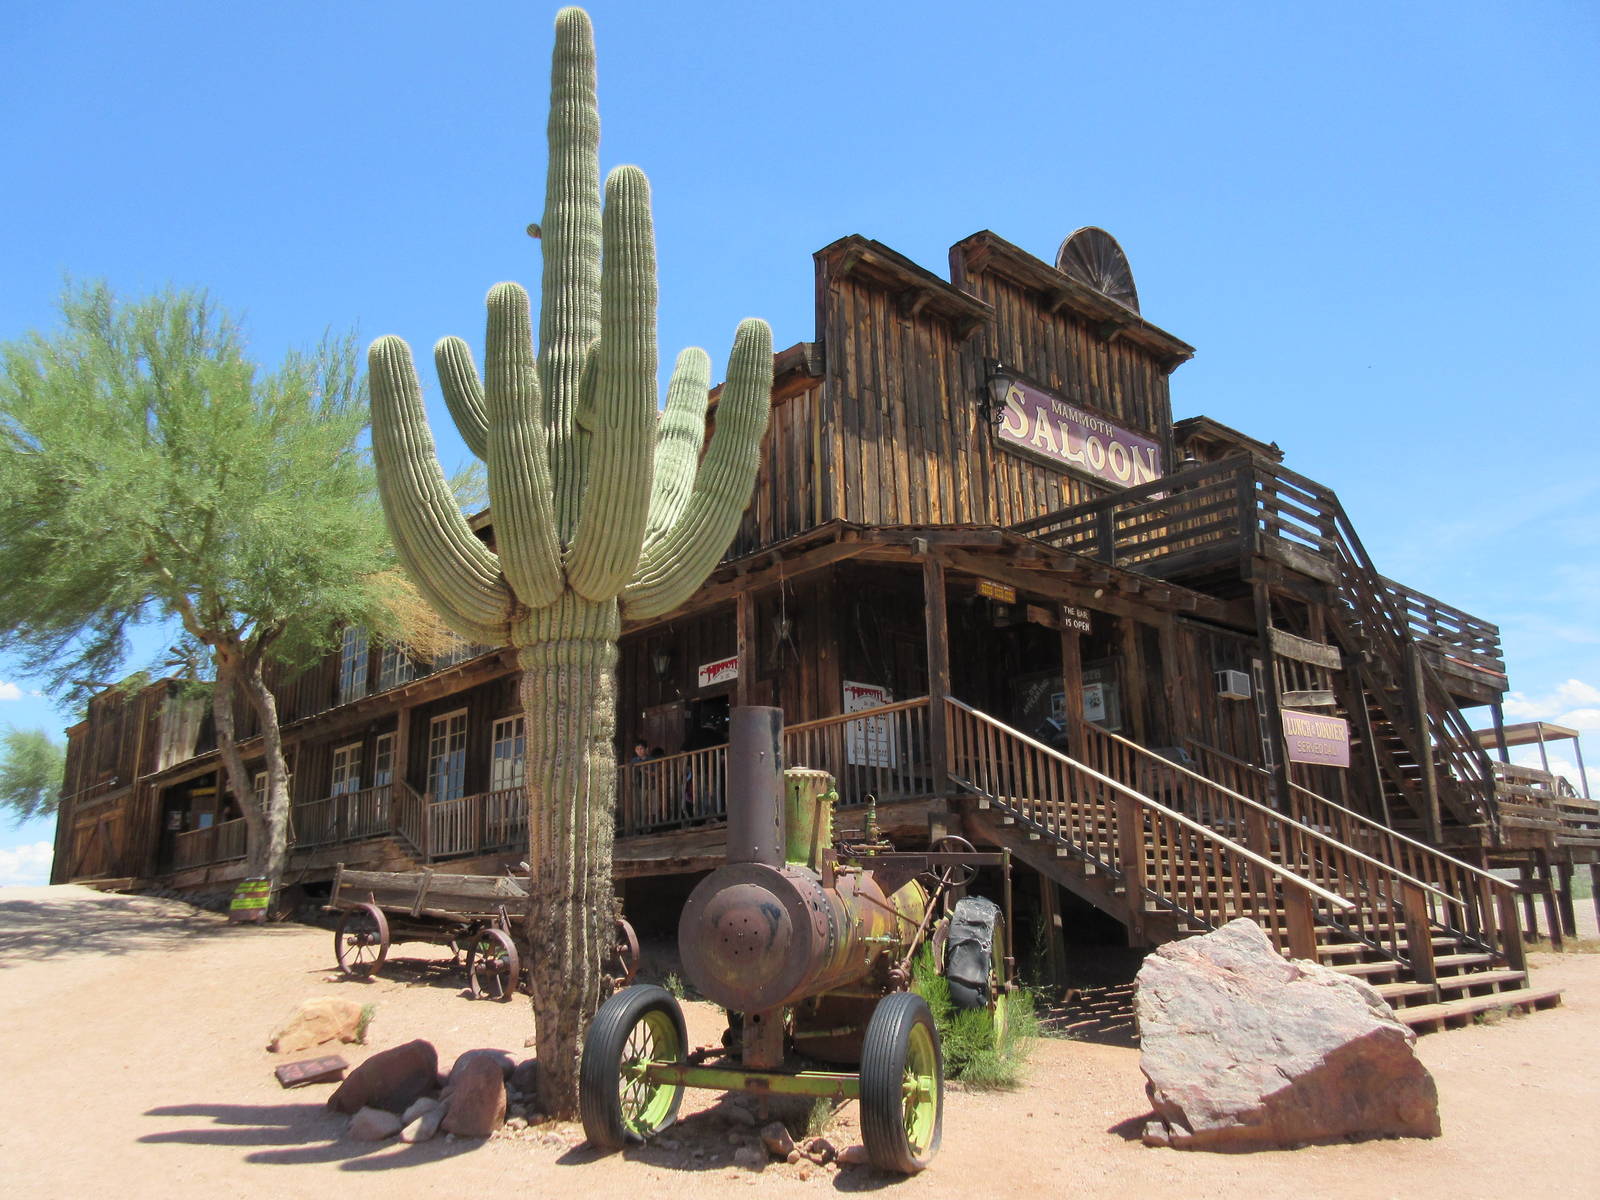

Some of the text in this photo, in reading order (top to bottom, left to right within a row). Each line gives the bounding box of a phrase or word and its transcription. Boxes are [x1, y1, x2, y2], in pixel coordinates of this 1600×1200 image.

[1051, 400, 1114, 437] MAMMOTH
[1002, 383, 1156, 486] SALOON
[1063, 605, 1075, 615] THE
[1065, 618, 1090, 631] IS OPEN
[1286, 717, 1312, 737] LUNCH
[1315, 720, 1345, 742] DINNER
